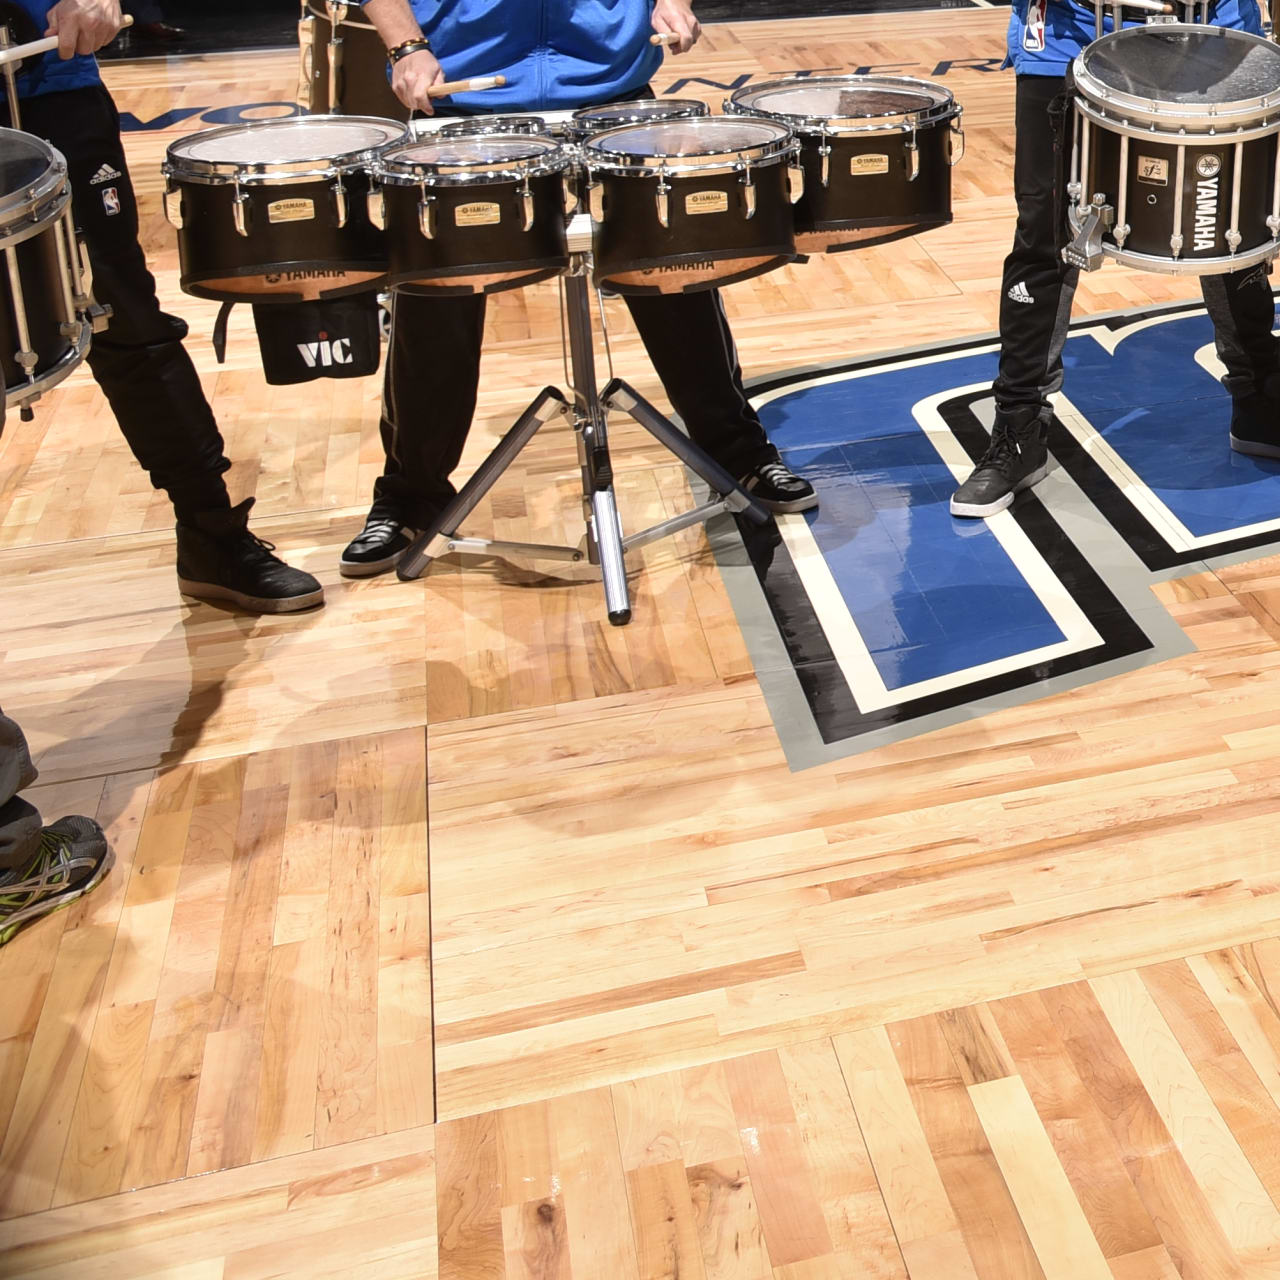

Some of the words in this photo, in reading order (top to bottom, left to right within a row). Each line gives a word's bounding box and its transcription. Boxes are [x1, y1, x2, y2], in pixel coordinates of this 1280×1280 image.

[90, 171, 122, 185] adidas
[1193, 177, 1220, 252] YAMAHA
[1007, 290, 1034, 304] adidas
[296, 337, 354, 368] VIC
